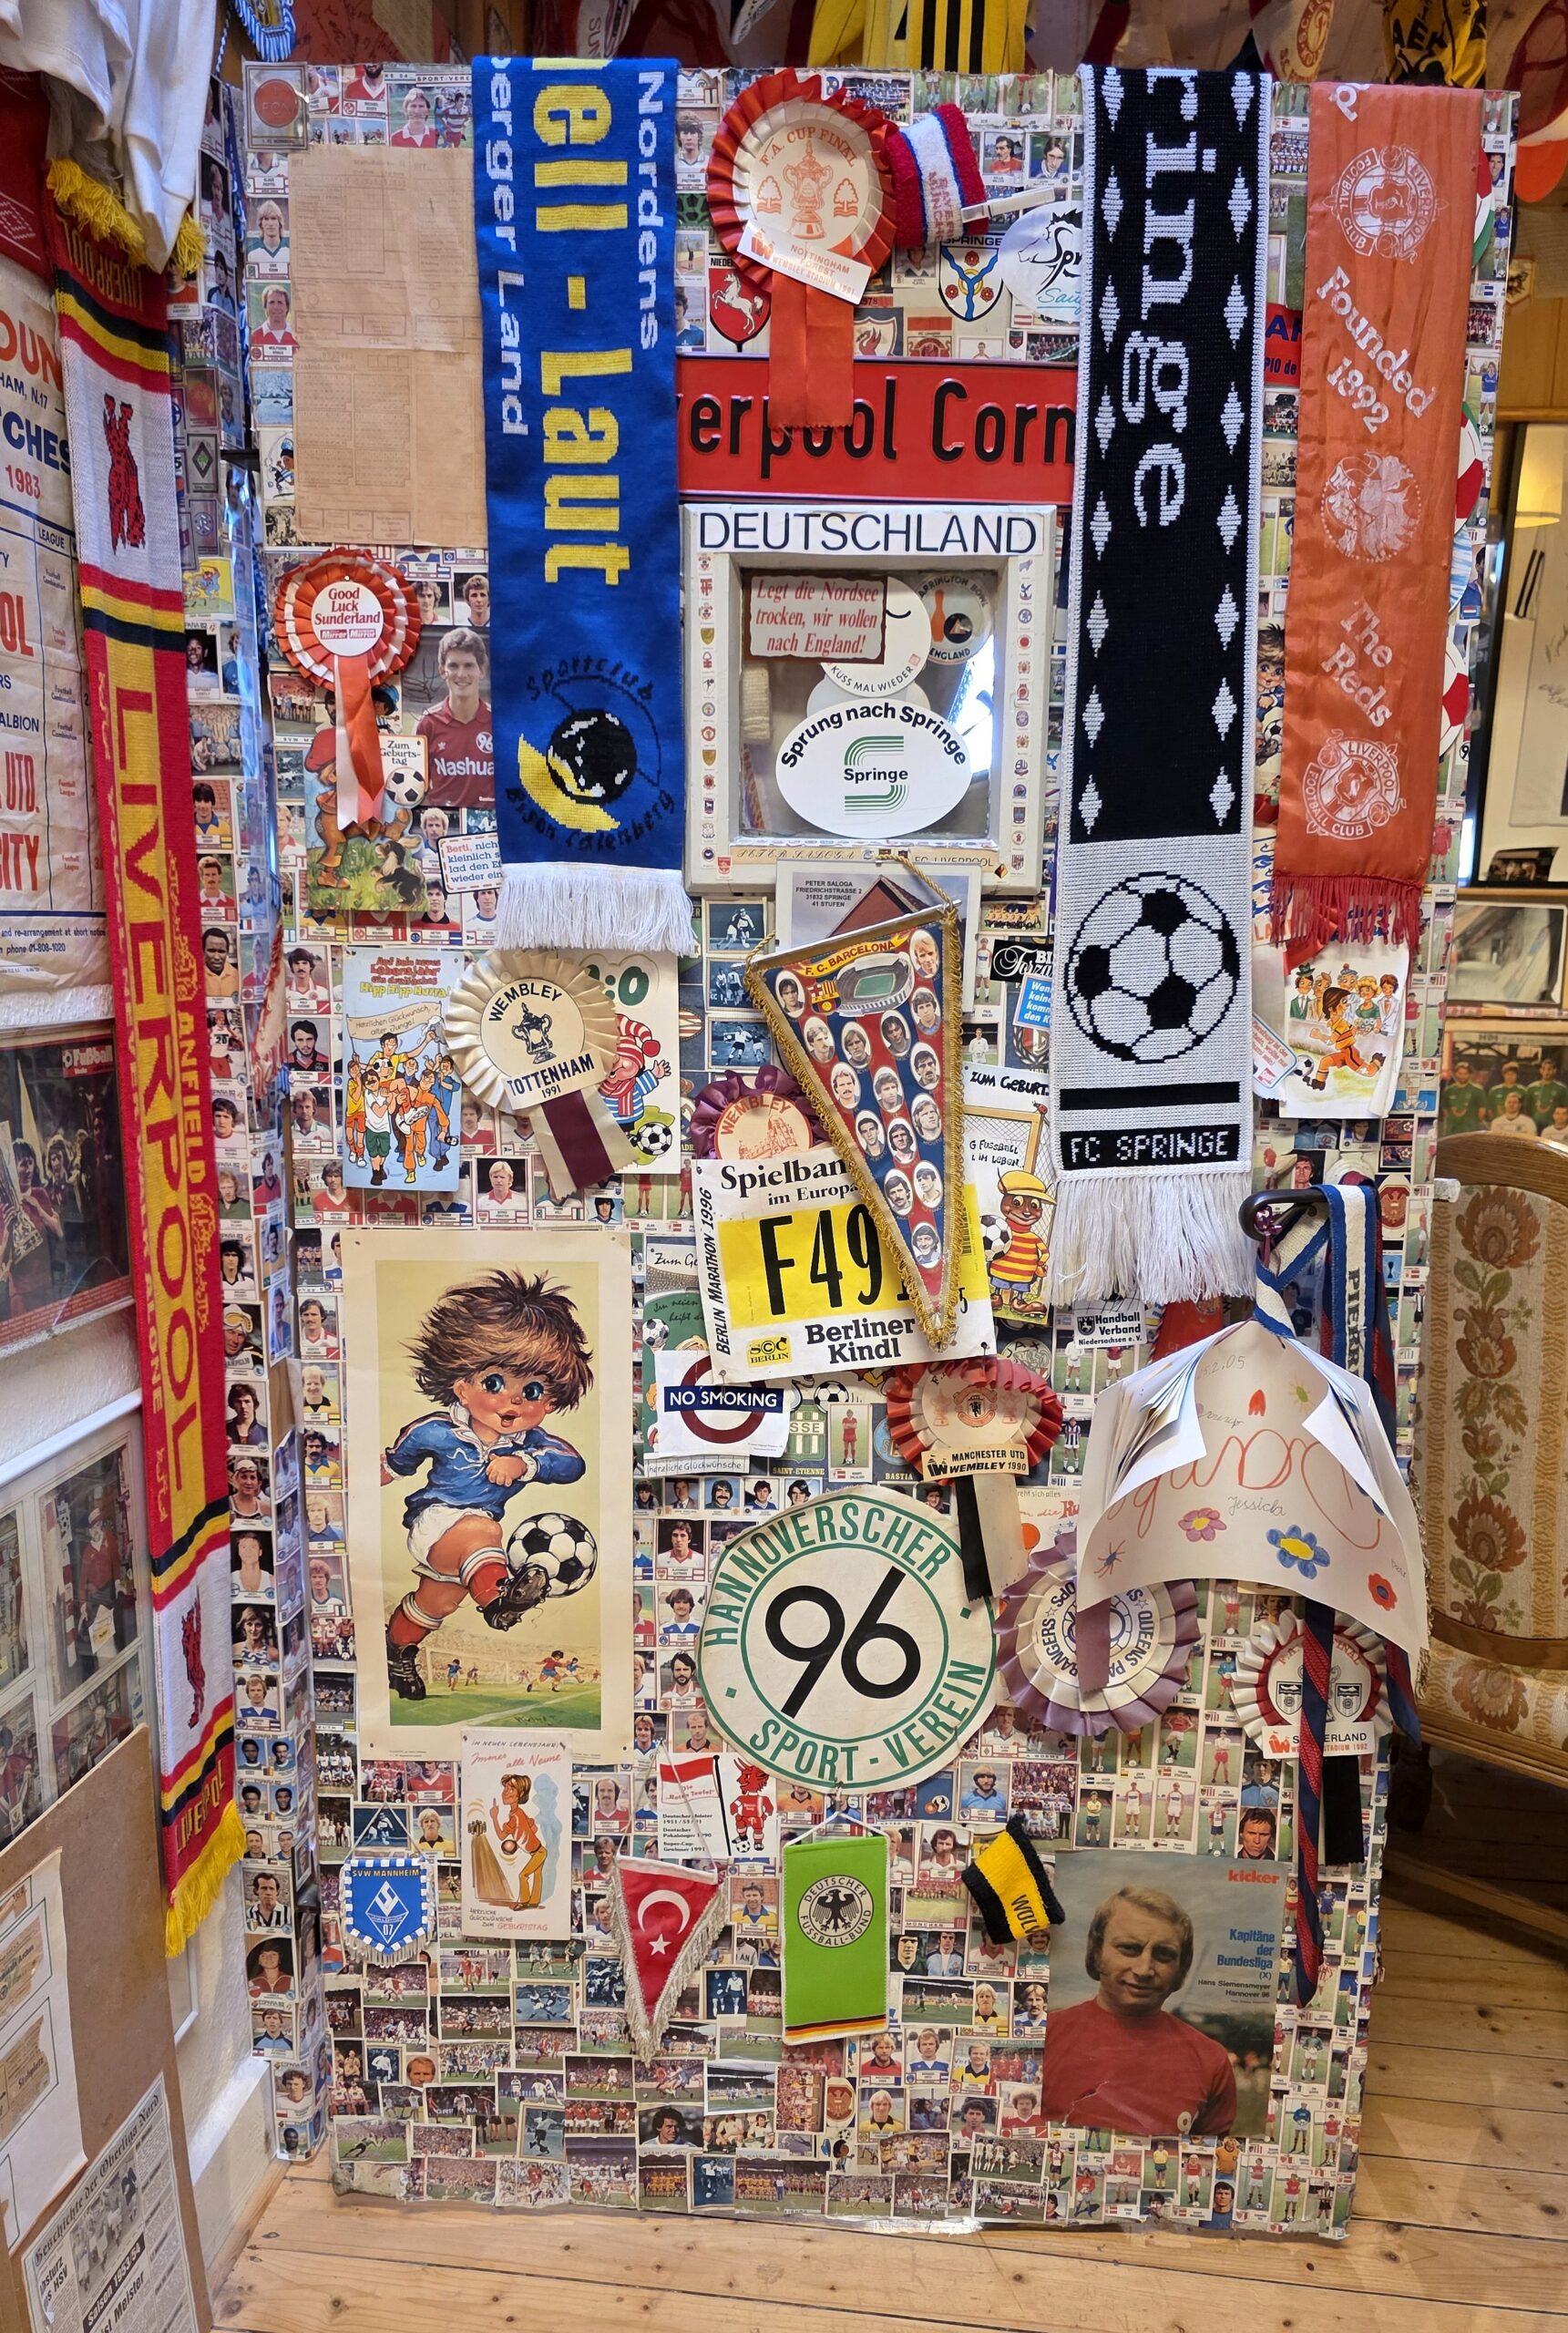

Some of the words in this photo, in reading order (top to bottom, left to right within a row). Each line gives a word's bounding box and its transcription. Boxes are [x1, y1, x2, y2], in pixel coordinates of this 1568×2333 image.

[490, 57, 518, 252] erger
[532, 57, 628, 231] ell
[786, 127, 816, 144] CUP
[818, 128, 859, 168] FINAL
[1339, 155, 1372, 211] FOOTBALL
[637, 70, 663, 351] Nordens
[1408, 164, 1432, 242] LIVERPOOL
[1342, 217, 1367, 249] CLUB
[790, 243, 849, 273] NOTTINGHAM
[800, 258, 835, 276] FOREST
[1316, 265, 1436, 418] Founded
[497, 271, 528, 436] Land
[1326, 357, 1389, 434] 1892
[676, 375, 898, 480] erpool
[5, 465, 41, 500] 1983
[38, 528, 65, 549] LEAGUE
[700, 512, 1037, 553] DEUTSCHLAND
[328, 587, 360, 600] Good
[756, 580, 789, 604] Legt
[794, 581, 815, 600] die
[821, 581, 879, 602] Nordsee
[332, 601, 358, 612] Luck
[314, 612, 381, 625] Sunderland
[756, 607, 806, 629] trocken,
[813, 610, 833, 628] wir
[839, 610, 877, 629] wollen
[1340, 599, 1394, 668] The
[767, 634, 800, 652] nach
[804, 634, 866, 656] England!
[928, 647, 971, 661] ENGLAND
[831, 665, 852, 687] KUSS
[854, 682, 876, 693] MAL
[877, 665, 914, 693] WIEDER
[1320, 642, 1393, 728] Reds
[387, 740, 409, 749] Zum
[781, 709, 844, 768] Sprung
[845, 702, 897, 721] nach
[899, 704, 966, 766] Springe
[391, 756, 408, 766] tag
[435, 756, 495, 776] Nashua
[1347, 741, 1396, 795] LIVERPOOL
[5, 751, 40, 814] UTD.
[843, 767, 908, 785] Springe
[1305, 771, 1328, 829] FOOTBALL
[1331, 824, 1365, 838] CLUB
[447, 852, 492, 863] kleinlich
[448, 865, 466, 874] lad
[469, 862, 489, 872] den
[451, 872, 486, 884] wieder
[15, 928, 62, 938] re-arrangement
[6, 944, 26, 954] phone
[804, 966, 815, 975] F.
[815, 962, 827, 973] C.
[828, 940, 896, 966] BARCELONA
[360, 982, 386, 998] Hipp
[386, 985, 413, 999] Hipp
[414, 985, 451, 998] Hurra!
[488, 982, 564, 1023] WEMBLEY
[355, 1018, 386, 1029] Herzlichen
[371, 1027, 386, 1035] alter
[390, 1018, 415, 1033] Junge!
[1024, 1012, 1042, 1022] den
[73, 1048, 113, 1066] Fußball
[506, 1053, 596, 1096] TOTTENHAM
[969, 1071, 996, 1087] ZUM
[116, 686, 198, 1492] LIVERPOOL
[178, 1008, 207, 1184] ANFIELD
[540, 1085, 563, 1099] 1991
[720, 1095, 792, 1135] WEMBLEY
[1070, 1136, 1102, 1163] FC
[1116, 1130, 1230, 1162] SPRINGE
[699, 1187, 713, 1231] 1996
[767, 1191, 792, 1207] im
[653, 1251, 682, 1266] Zum
[703, 1234, 724, 1304] MARATHON
[759, 1203, 913, 1316] F49
[1095, 1312, 1141, 1325] Handball
[712, 1307, 731, 1356] BERLIN
[805, 1317, 915, 1346] Berliner
[1078, 1336, 1126, 1345] Niedersachsen
[1099, 1324, 1142, 1336] Verband
[751, 1352, 789, 1364] BERLIN
[829, 1338, 901, 1364] Kindl
[670, 1392, 696, 1407] NO
[701, 1391, 777, 1408] SMOKING
[951, 1450, 1007, 1462] MANCHESTER
[1009, 1451, 1025, 1460] UTD
[649, 1461, 683, 1475] herzliche
[684, 1461, 742, 1472] Glückwünsche
[773, 1466, 825, 1475] SAINT-ETIENNE
[886, 1472, 913, 1481] BASTIA
[949, 1461, 1005, 1474] WEMBLEY
[1007, 1462, 1027, 1471] 1990
[1045, 1489, 1061, 1498] alles
[702, 1502, 951, 1647] HANNOVERSCHER
[765, 1566, 921, 1719] 96
[1125, 1610, 1155, 1667] QUEENS
[750, 1719, 858, 1782] SPORT
[884, 1660, 987, 1769] VEREIN
[506, 1757, 525, 1768] alle
[374, 1869, 419, 1877] MANNHEIM
[1228, 1869, 1280, 1885] kicker
[804, 1877, 867, 1902] DEUTSCHER
[383, 1924, 394, 1936] 07
[497, 1922, 548, 1931] GEBURTSTAG
[800, 1909, 871, 1946] FUSSBALL-BUND
[1229, 1928, 1275, 1943] Kapitäne
[1256, 1945, 1274, 1956] der
[1217, 1954, 1273, 1969] Bundesliga
[1198, 1978, 1216, 1987] Hans
[1217, 1980, 1271, 1990] Siemensmeyer
[1259, 1971, 1272, 1981] (X)
[1225, 1989, 1260, 1999] Hannover
[1261, 1990, 1270, 1999] 96
[114, 2270, 145, 2319] Meister
[87, 2284, 113, 2327] Saison
